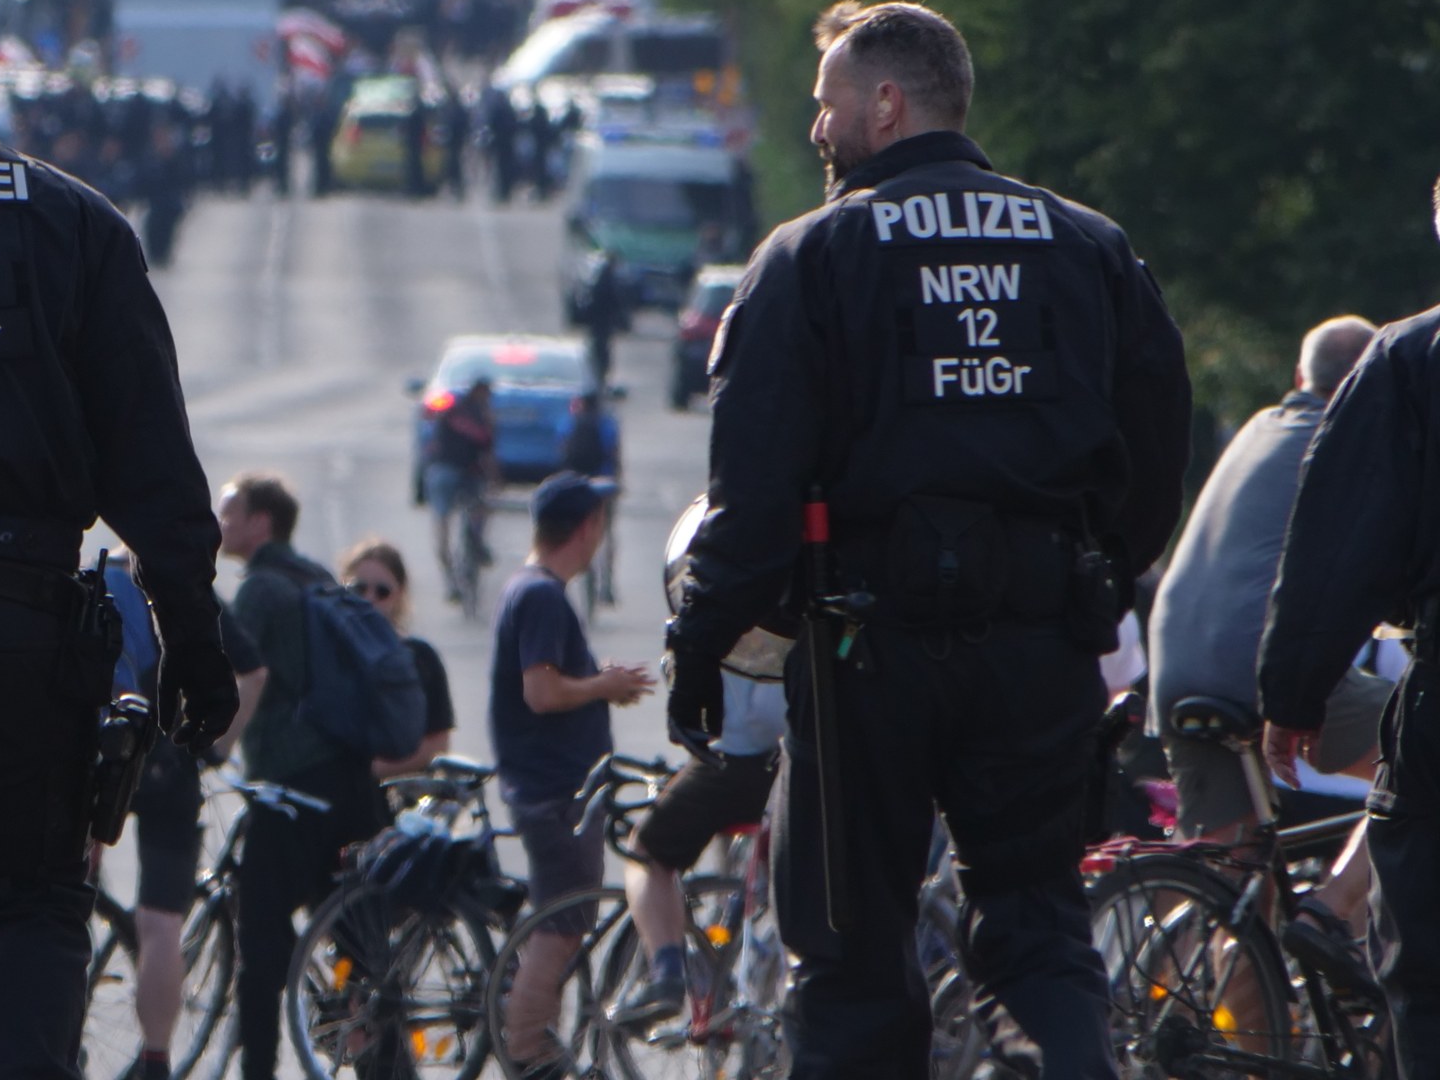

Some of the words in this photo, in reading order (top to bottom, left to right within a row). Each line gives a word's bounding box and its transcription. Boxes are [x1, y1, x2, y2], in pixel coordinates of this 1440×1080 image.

[871, 191, 1054, 242] POLIZEI
[919, 264, 1021, 305] NRW
[957, 308, 1001, 347] 12
[933, 356, 1032, 398] FüGr
